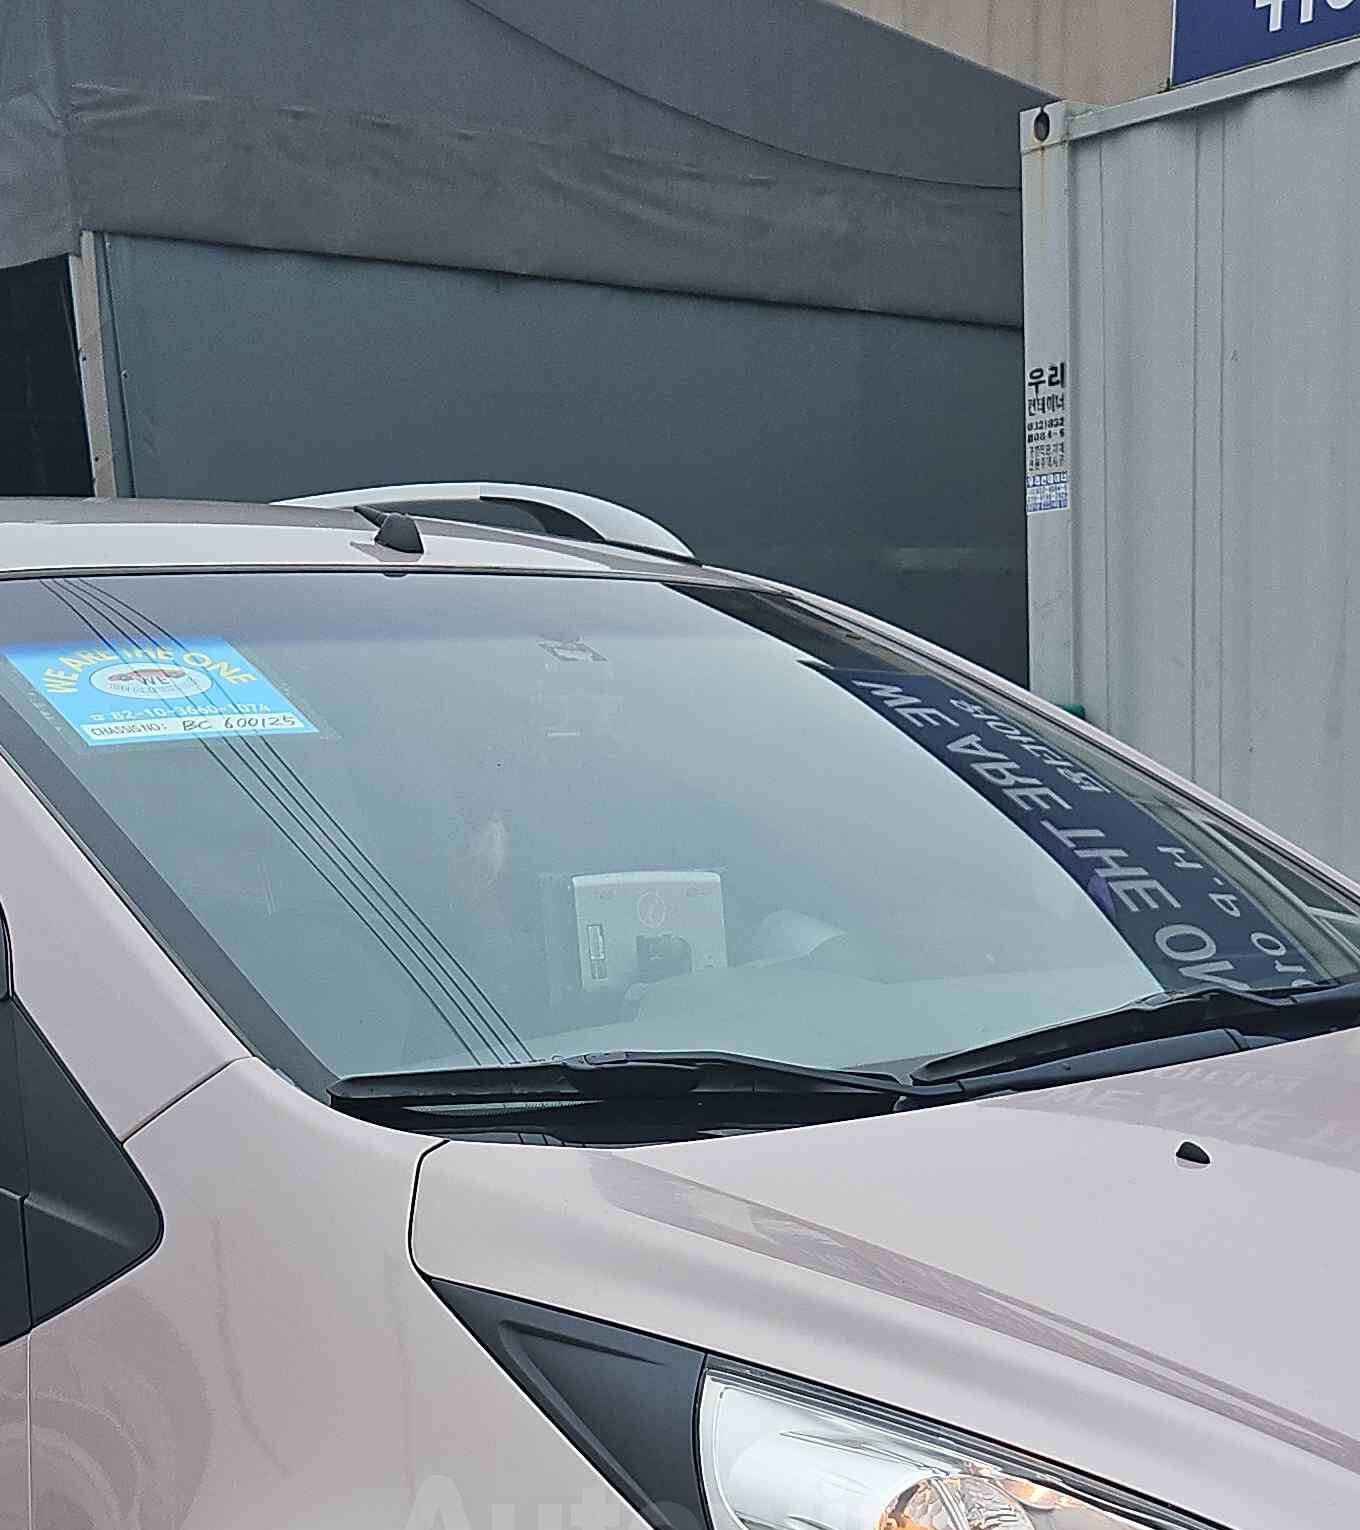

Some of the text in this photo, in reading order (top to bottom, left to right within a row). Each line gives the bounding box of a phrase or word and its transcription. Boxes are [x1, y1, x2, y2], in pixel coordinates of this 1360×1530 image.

[1028, 362, 1065, 396] 우리
[1027, 392, 1065, 417] 컨테이너
[42, 667, 79, 694] WE
[61, 648, 118, 673] ARE
[182, 652, 259, 685] ONE
